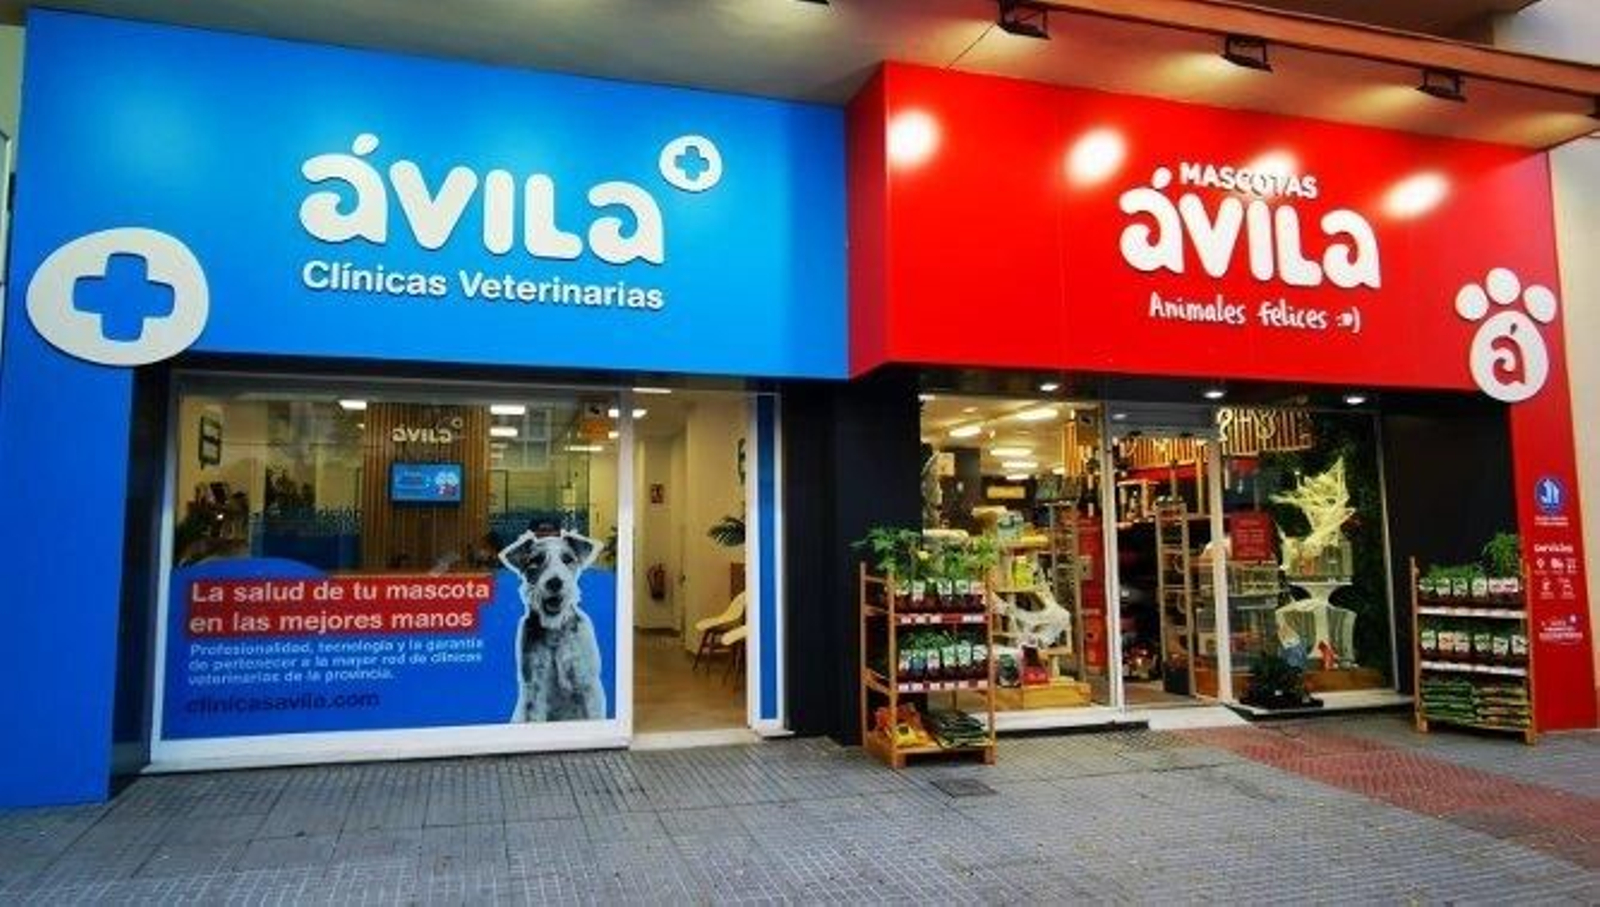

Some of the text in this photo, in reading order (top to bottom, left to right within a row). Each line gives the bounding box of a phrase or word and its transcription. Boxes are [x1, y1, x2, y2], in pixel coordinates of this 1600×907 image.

[1179, 162, 1318, 199] MASCOTAS
[302, 260, 664, 311] Clínicas Veterinarias
[1149, 292, 1247, 325] Animales
[1258, 298, 1327, 330] felices
[192, 580, 490, 603] La salud de tu mascota
[190, 610, 473, 634] en las mejores manos
[190, 641, 313, 656] Profesionalidad,
[319, 639, 393, 654] tecnología
[397, 641, 406, 653] y
[409, 639, 422, 650] la
[189, 659, 209, 671] de
[315, 656, 328, 667] la
[332, 657, 377, 668] mayor
[382, 653, 406, 665] red
[409, 654, 427, 664] de
[284, 671, 302, 682] de
[307, 670, 321, 681] la
[188, 693, 380, 711] clinicasavila.com
